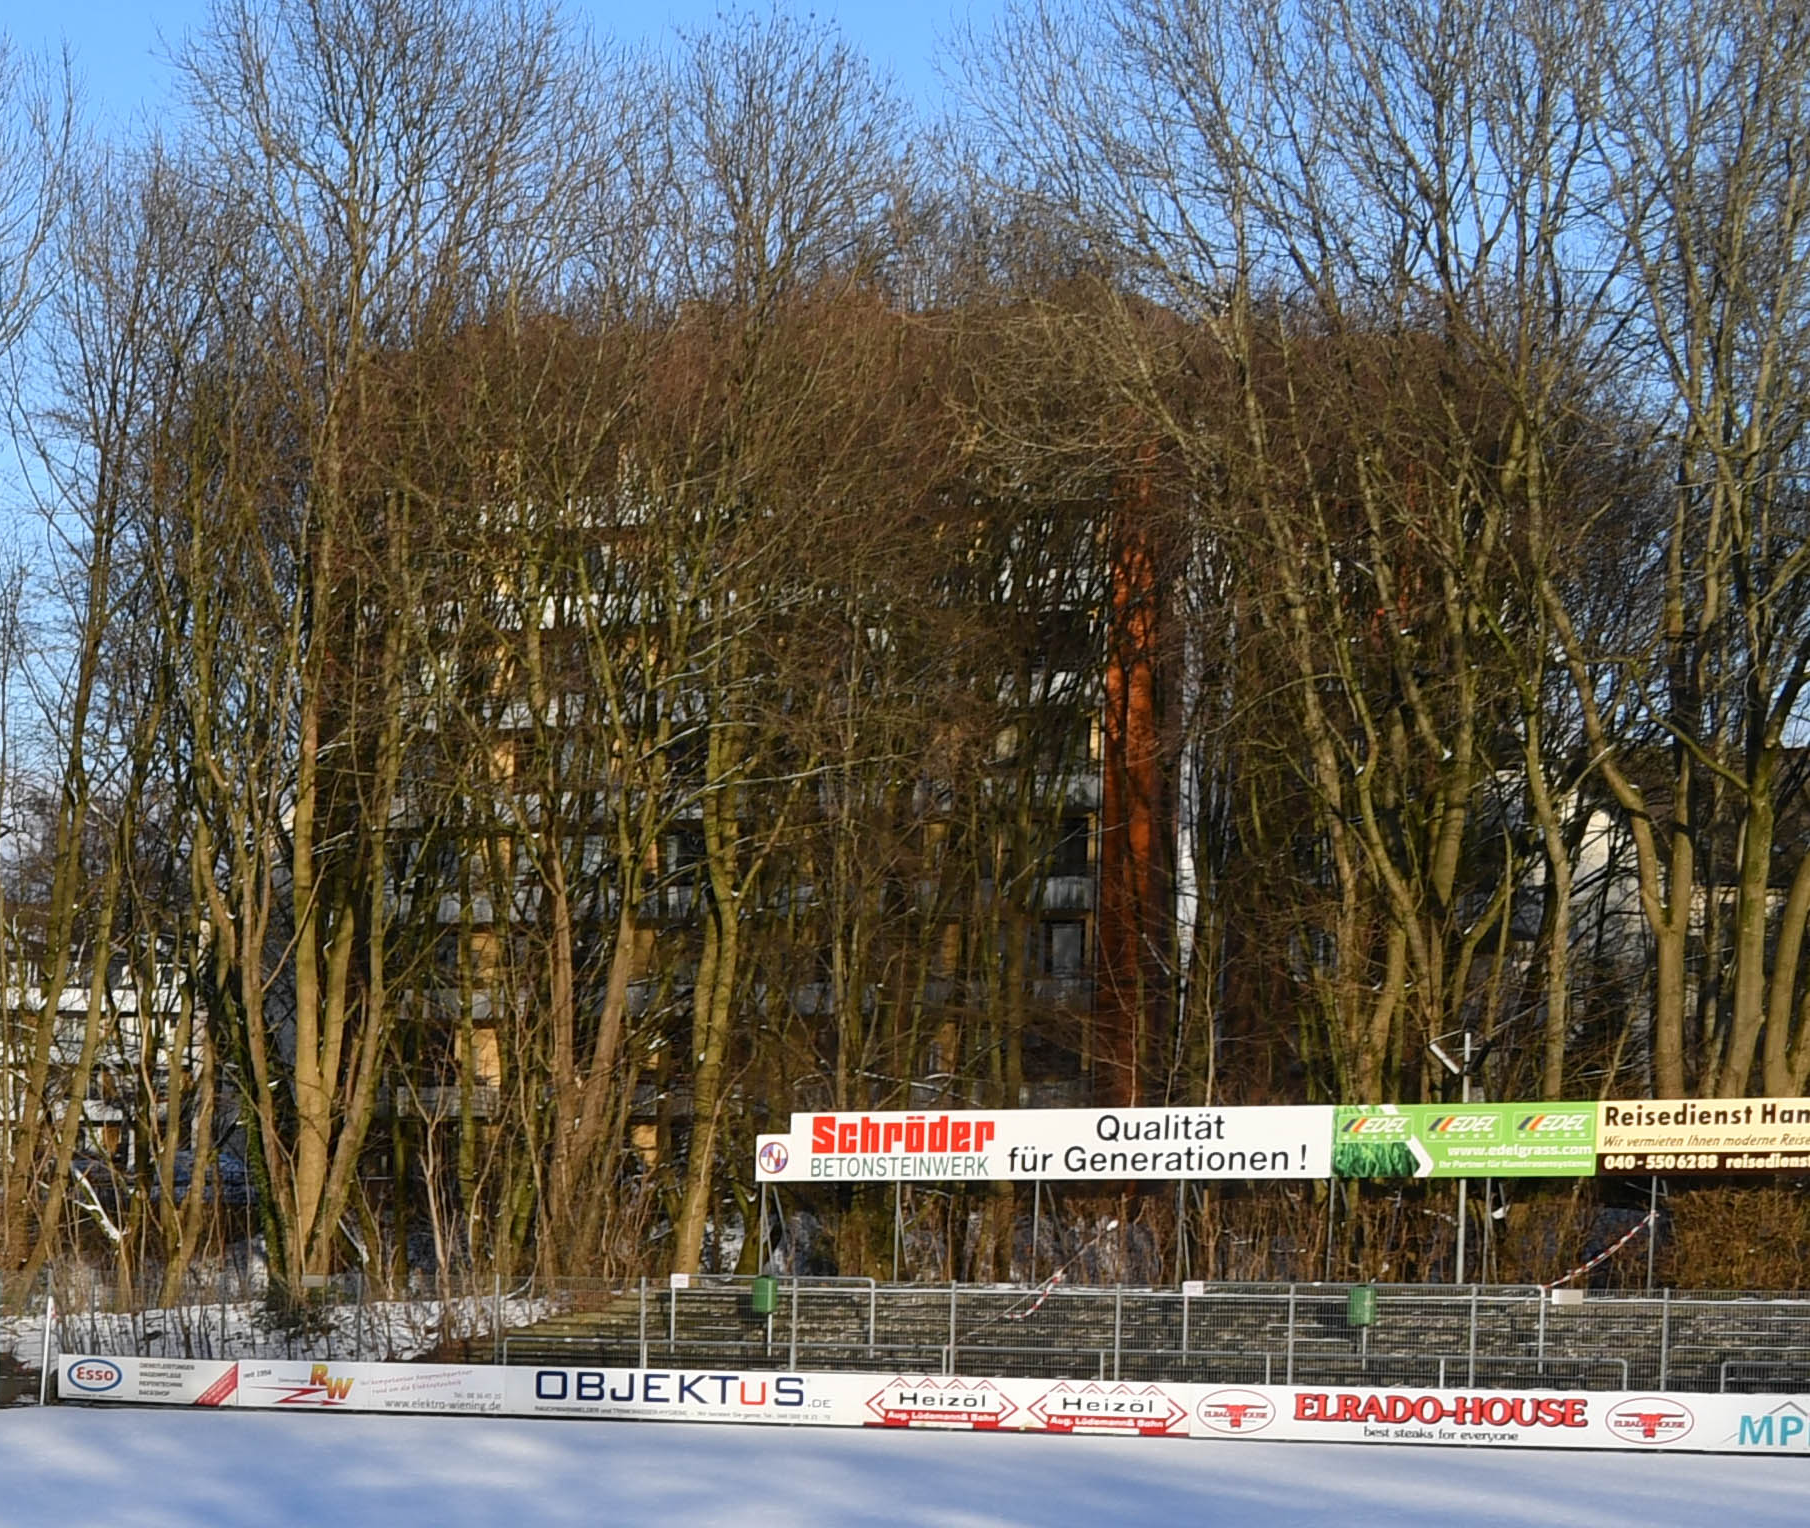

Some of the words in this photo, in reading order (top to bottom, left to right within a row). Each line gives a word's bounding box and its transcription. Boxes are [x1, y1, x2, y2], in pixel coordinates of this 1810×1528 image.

[1448, 1115, 1497, 1132] EDEL
[1536, 1114, 1590, 1131] EDEL
[1605, 1103, 1752, 1127] Reisedienst
[1096, 1113, 1225, 1142] Qualität
[1361, 1116, 1410, 1133] EDEL
[812, 1115, 995, 1154] Schröder
[1604, 1135, 1624, 1147] Wir
[1628, 1135, 1684, 1147] vermieten
[1687, 1134, 1720, 1147] Ihnen
[1723, 1134, 1776, 1146] moderne
[1008, 1146, 1053, 1173] für
[1064, 1145, 1289, 1173] Generationen
[1448, 1144, 1592, 1158] www.edelgrass.com
[1725, 1152, 1810, 1168] reisediens
[811, 1156, 989, 1178] BETONSTEINWERK
[900, 1391, 986, 1408] Heizöl
[1062, 1396, 1153, 1413] Heizöl
[1294, 1392, 1588, 1428] ELRADO-HOUSE
[1364, 1425, 1390, 1439] best
[1394, 1427, 1433, 1440] steaks
[1438, 1427, 1456, 1441] for
[1460, 1430, 1519, 1445] everyone
[1739, 1415, 1810, 1446] MP
